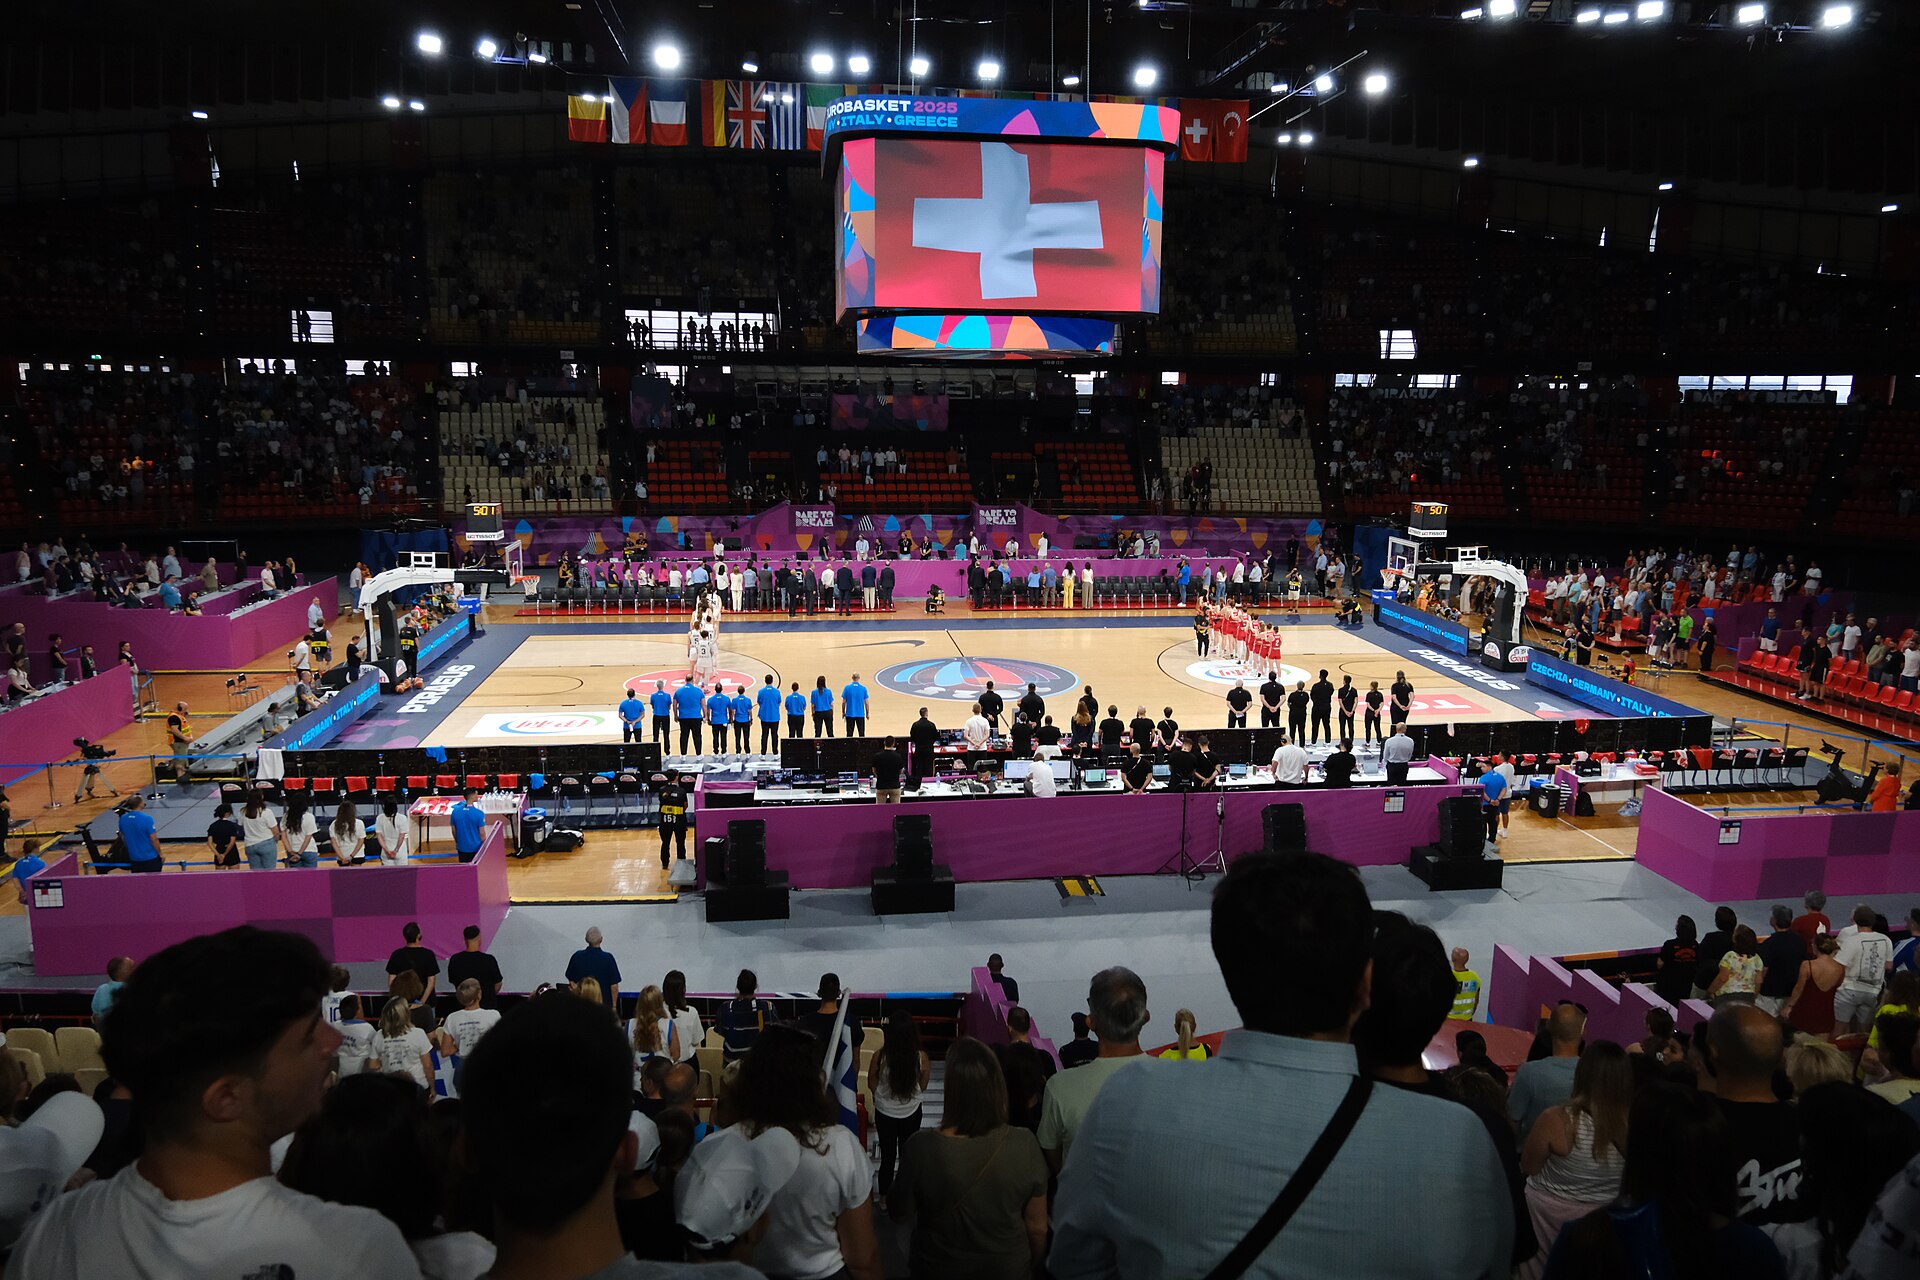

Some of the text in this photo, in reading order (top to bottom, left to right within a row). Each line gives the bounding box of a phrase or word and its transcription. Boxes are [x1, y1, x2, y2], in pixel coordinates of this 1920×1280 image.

[827, 99, 958, 117] UROBASKET 2025
[841, 114, 885, 127] ITALY
[894, 115, 958, 127] GREECE
[795, 510, 834, 518] DARE TO
[979, 509, 1017, 517] DARE TO
[979, 516, 1017, 525] DREAM
[795, 518, 834, 527] DREAM
[1408, 649, 1521, 691] PIRAEUS
[397, 664, 476, 713] PIRAEUS
[1531, 661, 1653, 717] CZECHIA GERMANY ITALY
[301, 683, 379, 746] GERMANY ITALY GREECE
